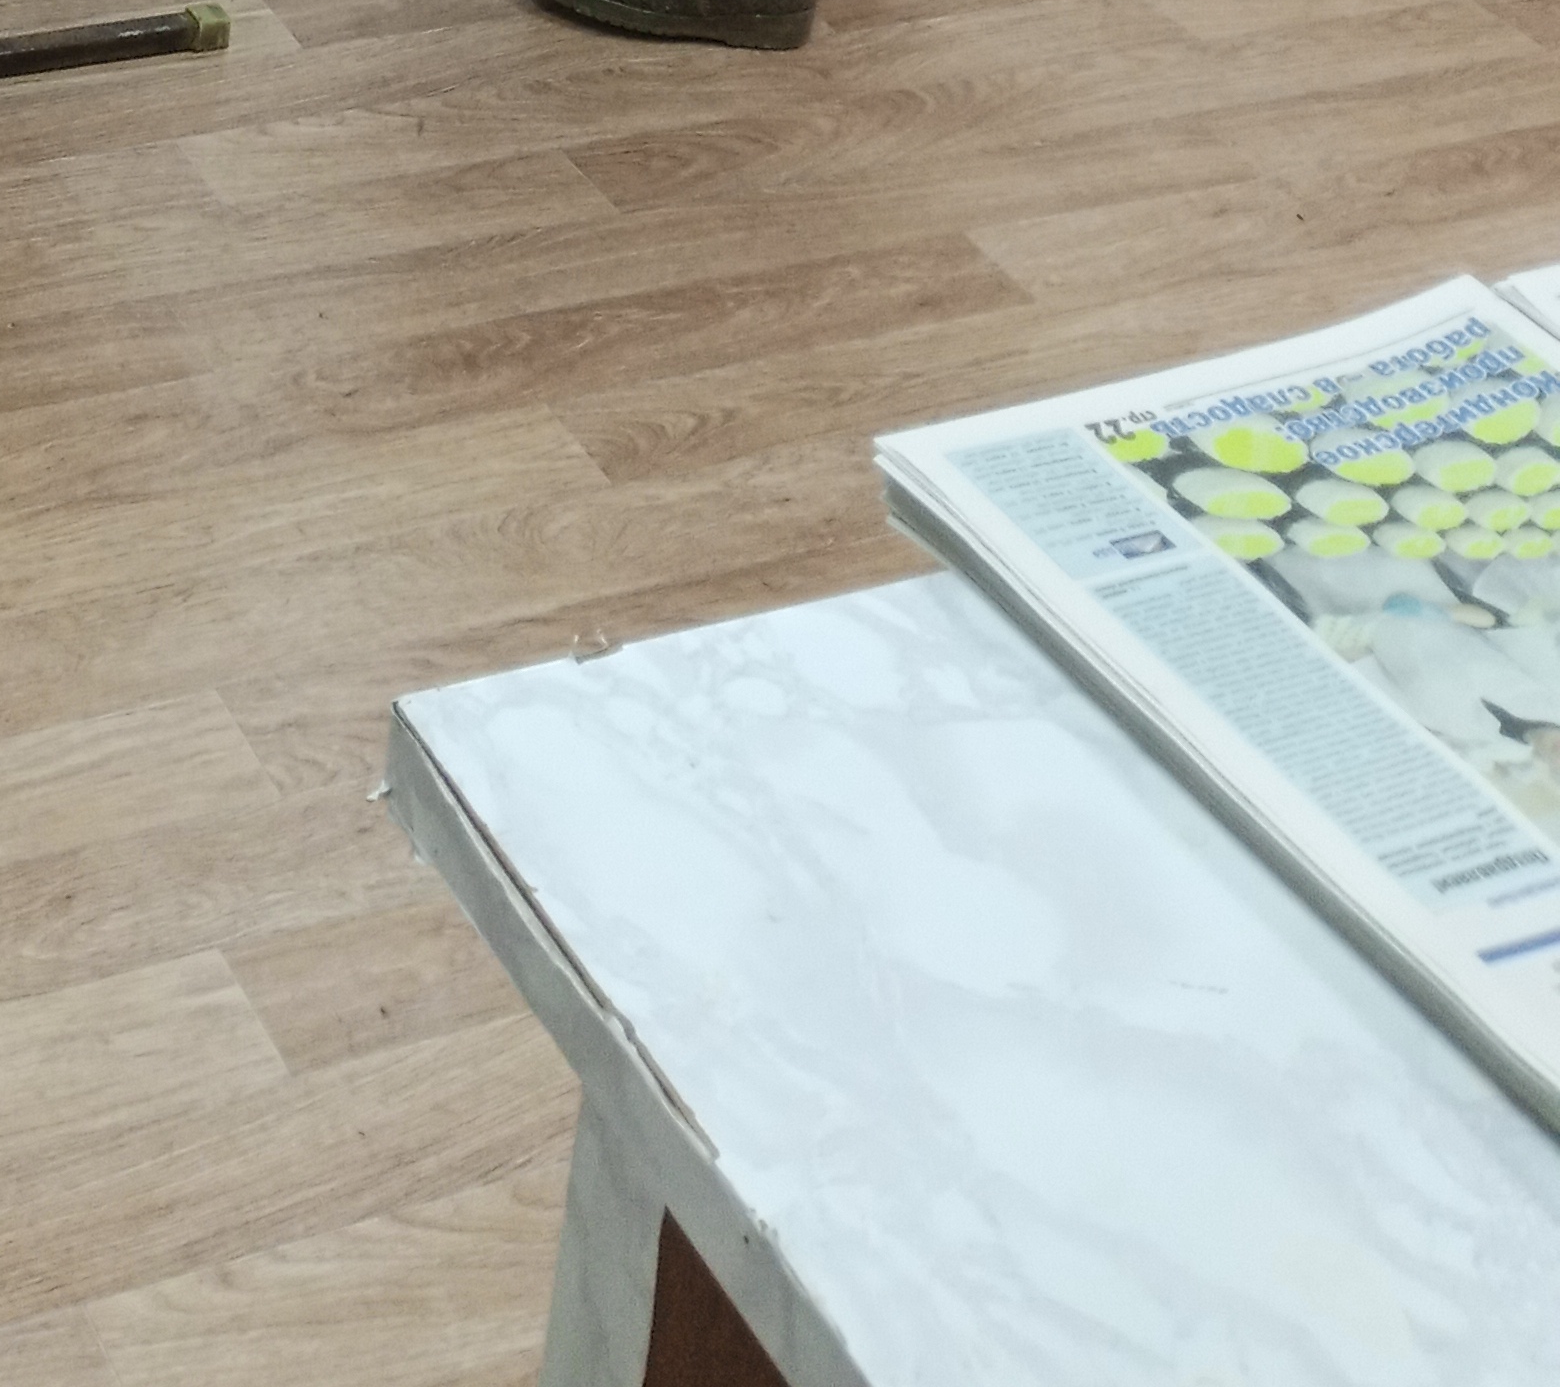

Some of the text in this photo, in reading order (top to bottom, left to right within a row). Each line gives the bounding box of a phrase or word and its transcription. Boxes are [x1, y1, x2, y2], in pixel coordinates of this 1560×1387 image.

[1369, 316, 1492, 377] работа
[1149, 385, 1312, 437] сладость
[1313, 377, 1339, 395] в
